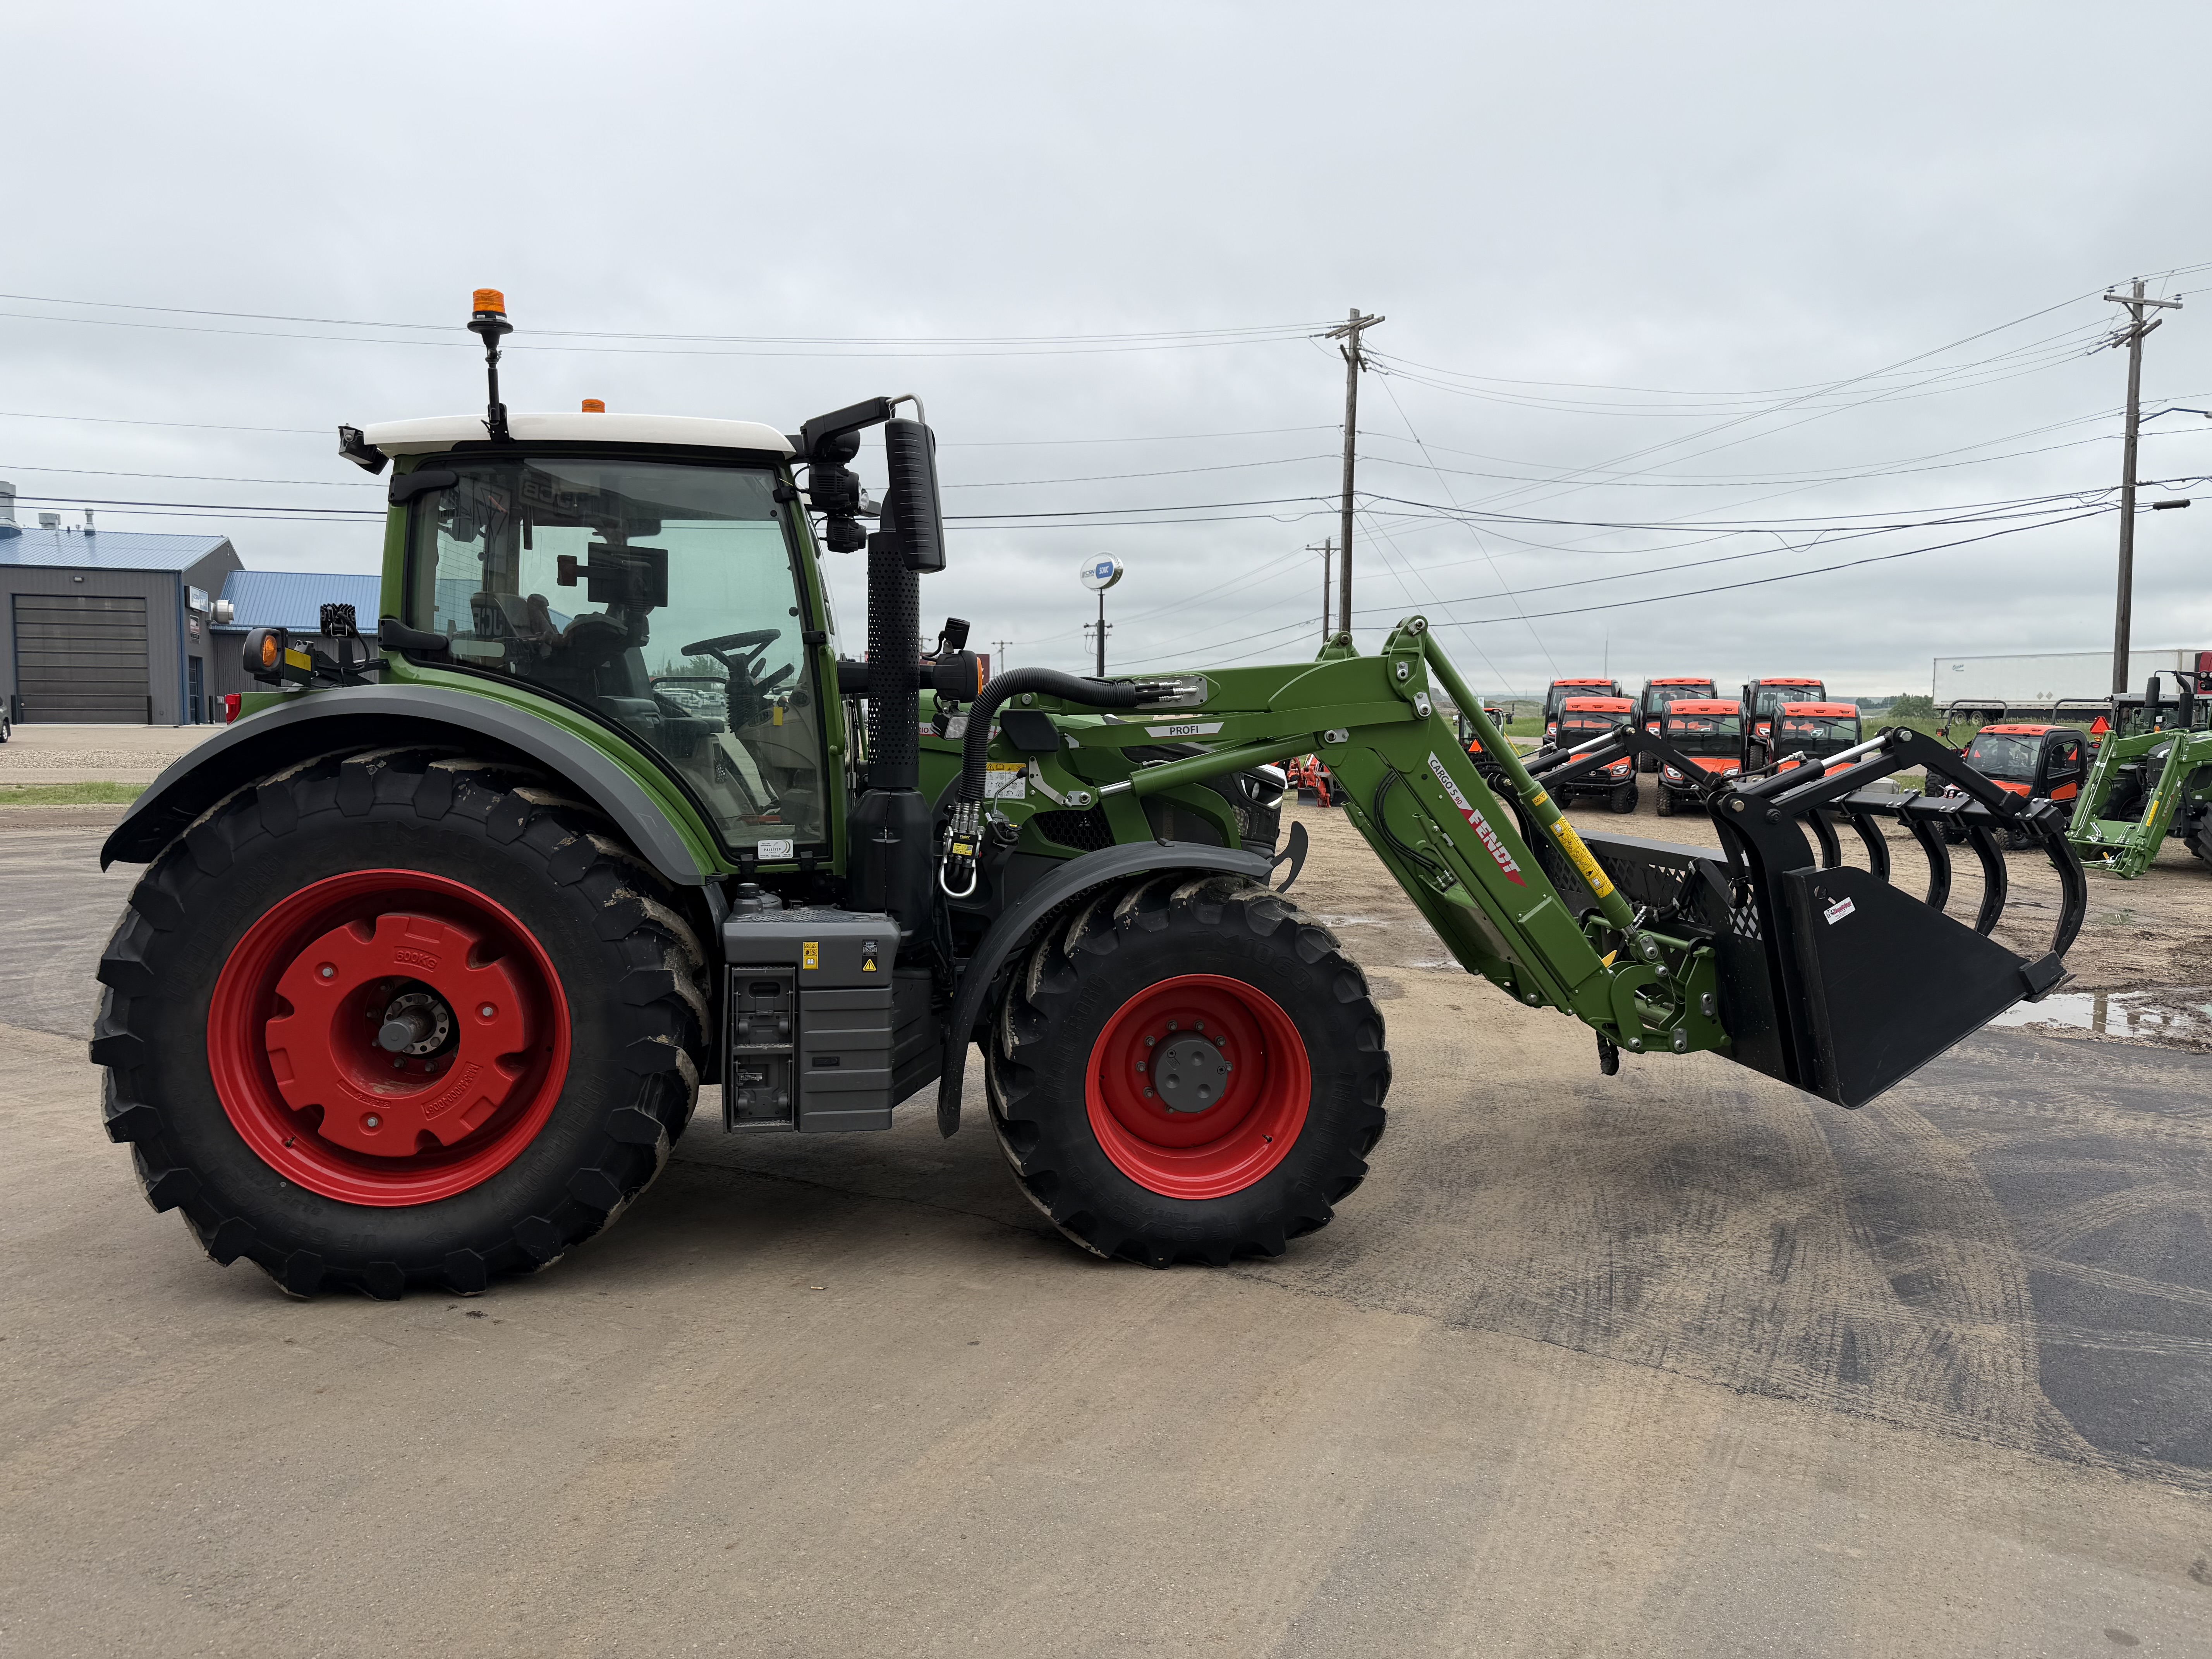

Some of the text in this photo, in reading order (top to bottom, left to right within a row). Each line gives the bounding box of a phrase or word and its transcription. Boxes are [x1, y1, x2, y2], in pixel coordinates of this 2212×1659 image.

[1170, 725, 1199, 735] PROFI
[1430, 759, 1453, 789] CARGO
[1454, 796, 1462, 805] 90
[1468, 808, 1521, 872] FENDT
[397, 950, 438, 968] 600KG
